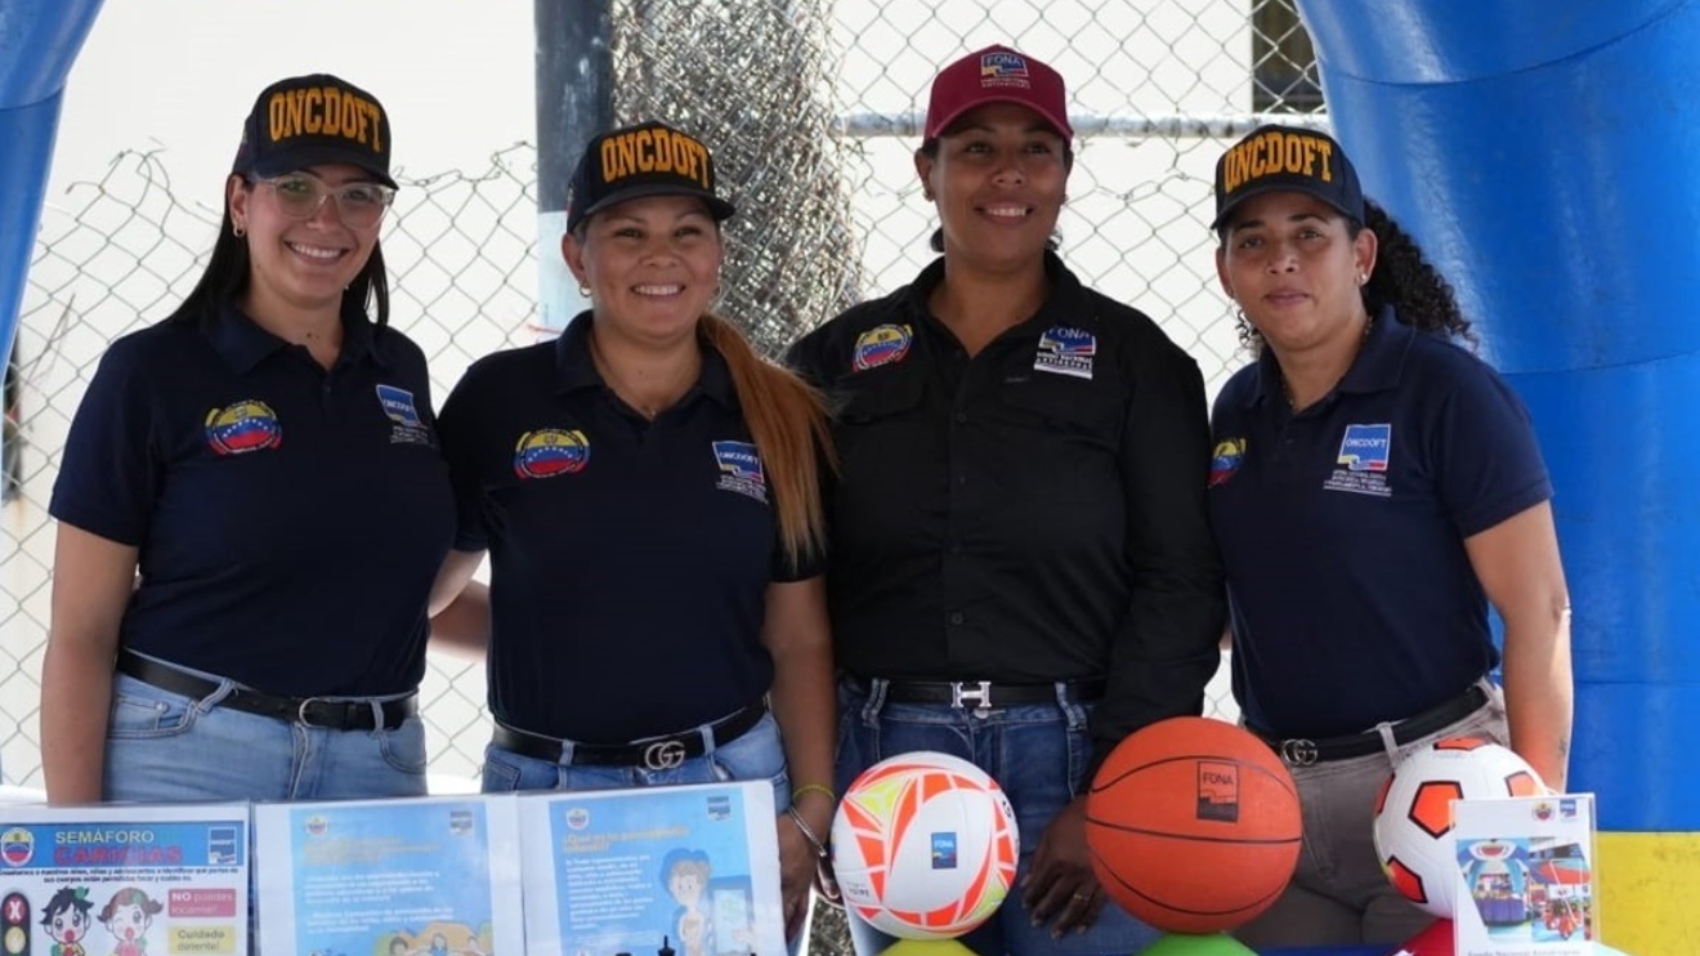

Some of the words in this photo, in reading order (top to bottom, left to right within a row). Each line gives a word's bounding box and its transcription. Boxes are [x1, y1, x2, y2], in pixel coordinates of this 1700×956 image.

[987, 54, 1022, 67] FONA
[269, 87, 382, 153] ONCDOFT
[601, 128, 709, 189] ONCDOFT
[1225, 131, 1332, 194] ONCDOFT
[1203, 772, 1234, 785] FONA
[55, 828, 155, 844] SEMÁFORO
[172, 892, 192, 902] NO
[178, 929, 225, 940] Cuidado
